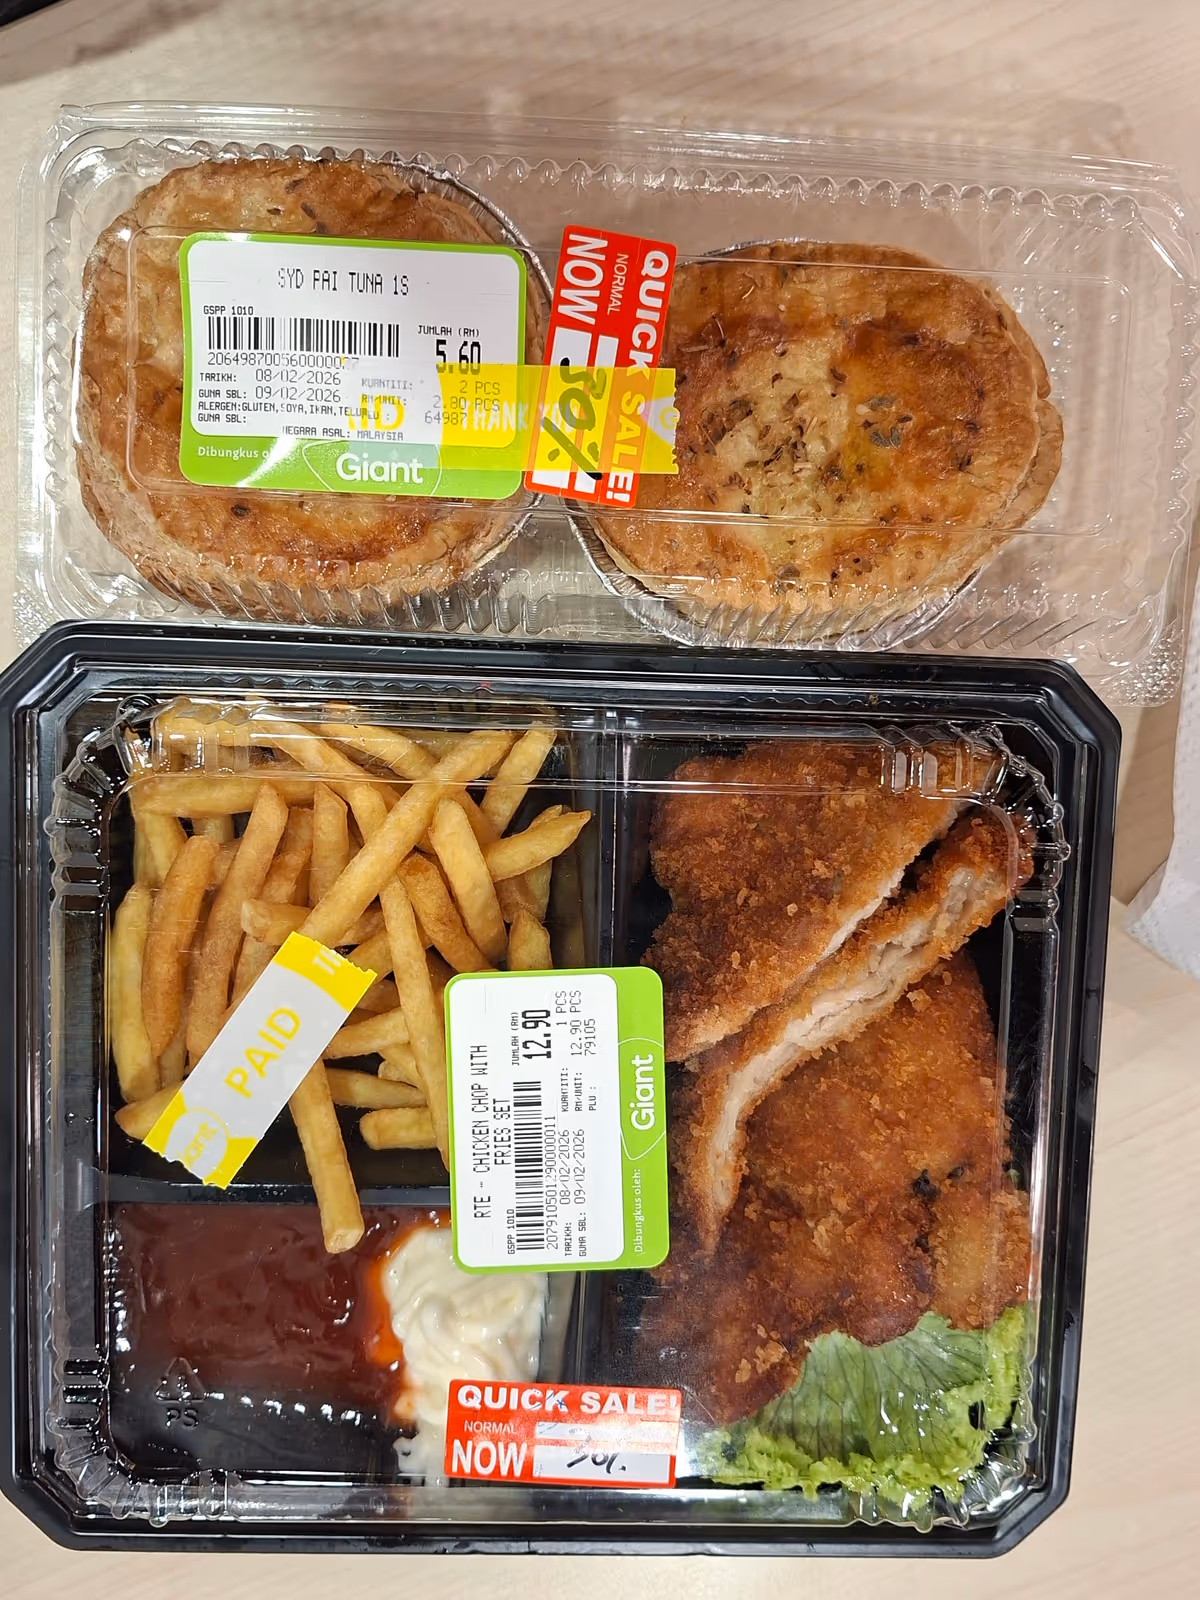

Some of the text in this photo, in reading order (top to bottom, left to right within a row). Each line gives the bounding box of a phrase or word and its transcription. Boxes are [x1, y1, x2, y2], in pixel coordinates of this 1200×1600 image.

[277, 267, 410, 296] SYD PAI TUNA 1S
[557, 233, 608, 325] NOW
[607, 253, 629, 316] NORMAL
[203, 305, 254, 316] GSPP 1010
[626, 250, 670, 381] QUICK
[417, 325, 480, 338] JUMLAH (RM)
[435, 339, 482, 375] 5.60
[198, 385, 342, 403] GUNA SBL: 09/02/2026
[199, 368, 342, 386] TARIKH: 08/02/2026
[361, 378, 501, 396] KUANTITI: 2 PCS
[198, 413, 247, 423] GUNA SBL:
[424, 410, 467, 426] 64987
[432, 395, 467, 410] 2.80
[474, 397, 501, 412] PCS
[541, 357, 608, 480] 30%
[322, 428, 351, 438] ASAL:
[357, 430, 404, 441] MALAYSIA
[606, 391, 646, 503] SALE!
[198, 446, 259, 460] Dibungkus
[336, 452, 424, 484] Giant
[555, 989, 567, 1014] PCS
[511, 1012, 519, 1066] JUMLAH (RM)
[521, 1009, 552, 1060] 12.90
[569, 989, 583, 1112] RM/UNIT: 12.90 PCS
[584, 1018, 596, 1057] 79105
[224, 1007, 301, 1099] PAID
[470, 1045, 488, 1076] WITH
[471, 1083, 489, 1114] CHOP
[561, 1067, 569, 1112] KUANTITI:
[588, 1095, 597, 1111] PLU
[631, 1053, 655, 1131] Giant
[472, 1120, 491, 1174] CHICKEN
[493, 1098, 511, 1166] FRIES SET
[558, 1128, 571, 1205] 08/02/2026
[473, 1195, 491, 1219] RTE
[573, 1128, 587, 1257] GUNA SBL: 09/02/2026
[633, 1168, 645, 1253] Dibungkus oleh:
[507, 1209, 515, 1255] GSPP 1010
[166, 1406, 199, 1428] PS
[457, 1384, 677, 1416] QUICK SALE!
[464, 1420, 517, 1434] NORMAL
[452, 1439, 528, 1477] NOW
